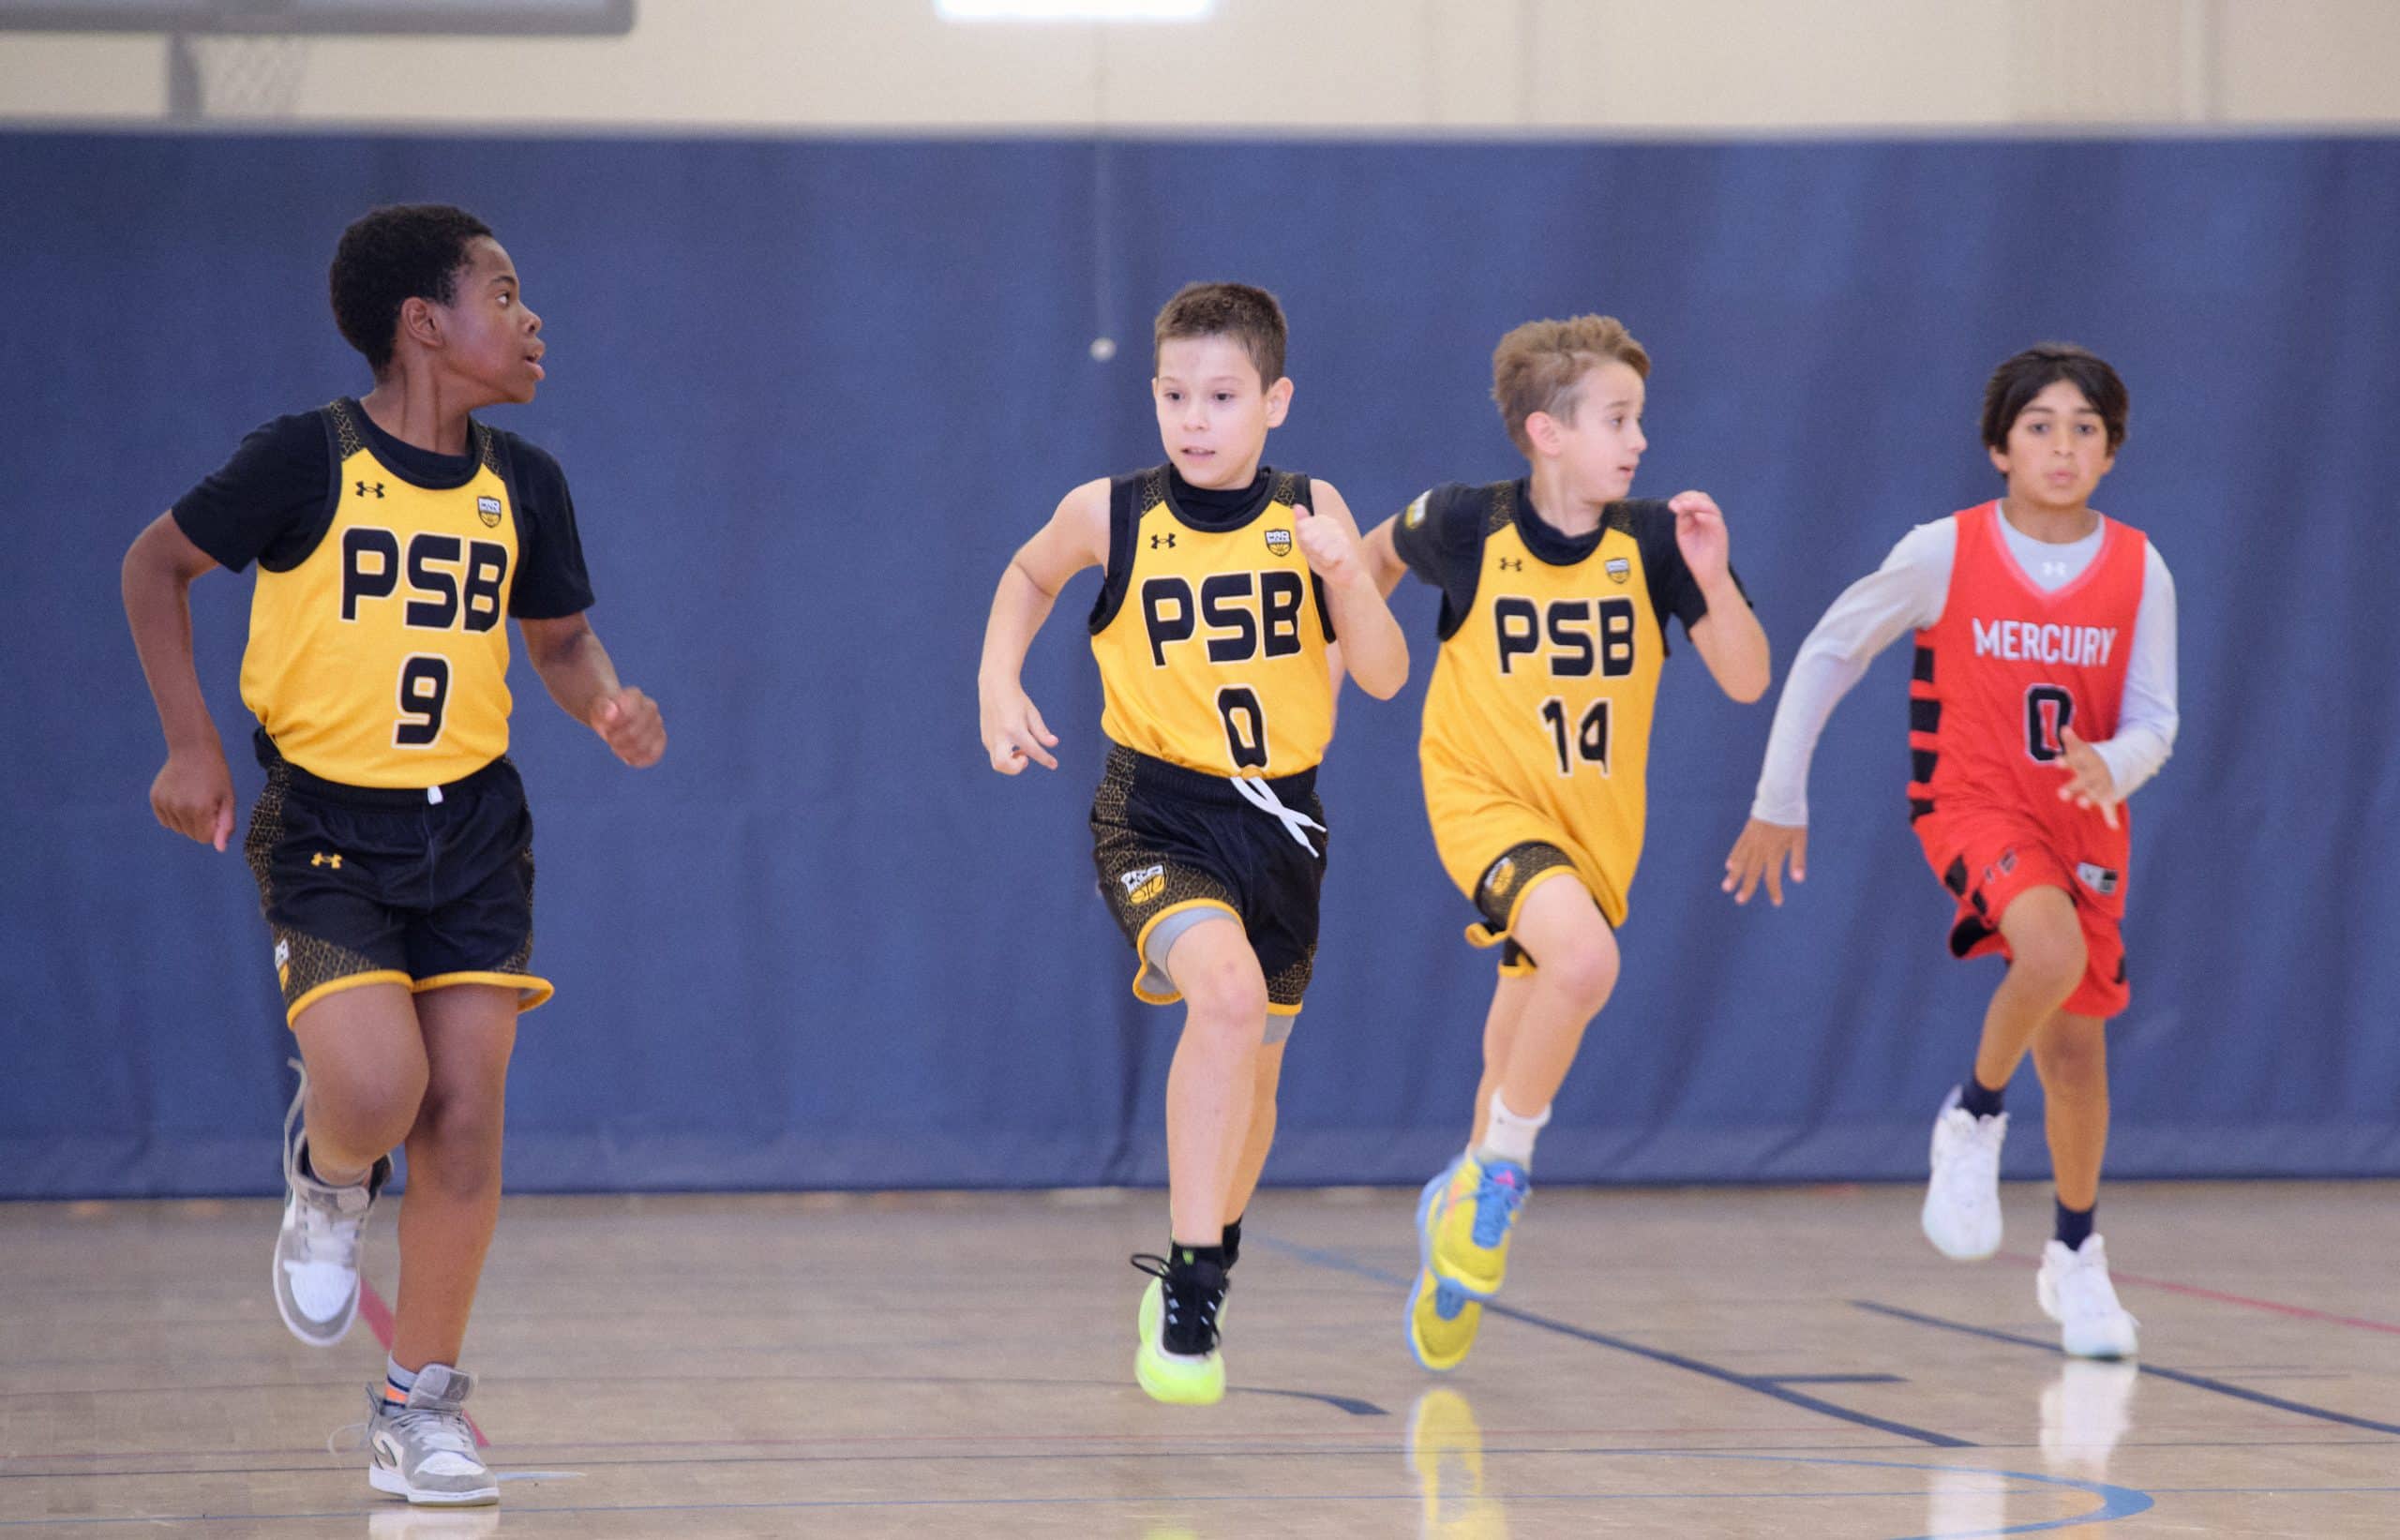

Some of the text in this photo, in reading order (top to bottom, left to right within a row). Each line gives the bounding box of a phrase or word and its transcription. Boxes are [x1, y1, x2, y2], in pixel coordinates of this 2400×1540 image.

[339, 526, 509, 633] PSB
[1141, 569, 1304, 668] PSB
[1493, 595, 1636, 678] PSB
[1972, 617, 2118, 667] MERCURY
[391, 651, 452, 750] 9
[1215, 682, 1270, 770] 0
[1539, 695, 1613, 778] 14
[2024, 682, 2077, 765] 0
